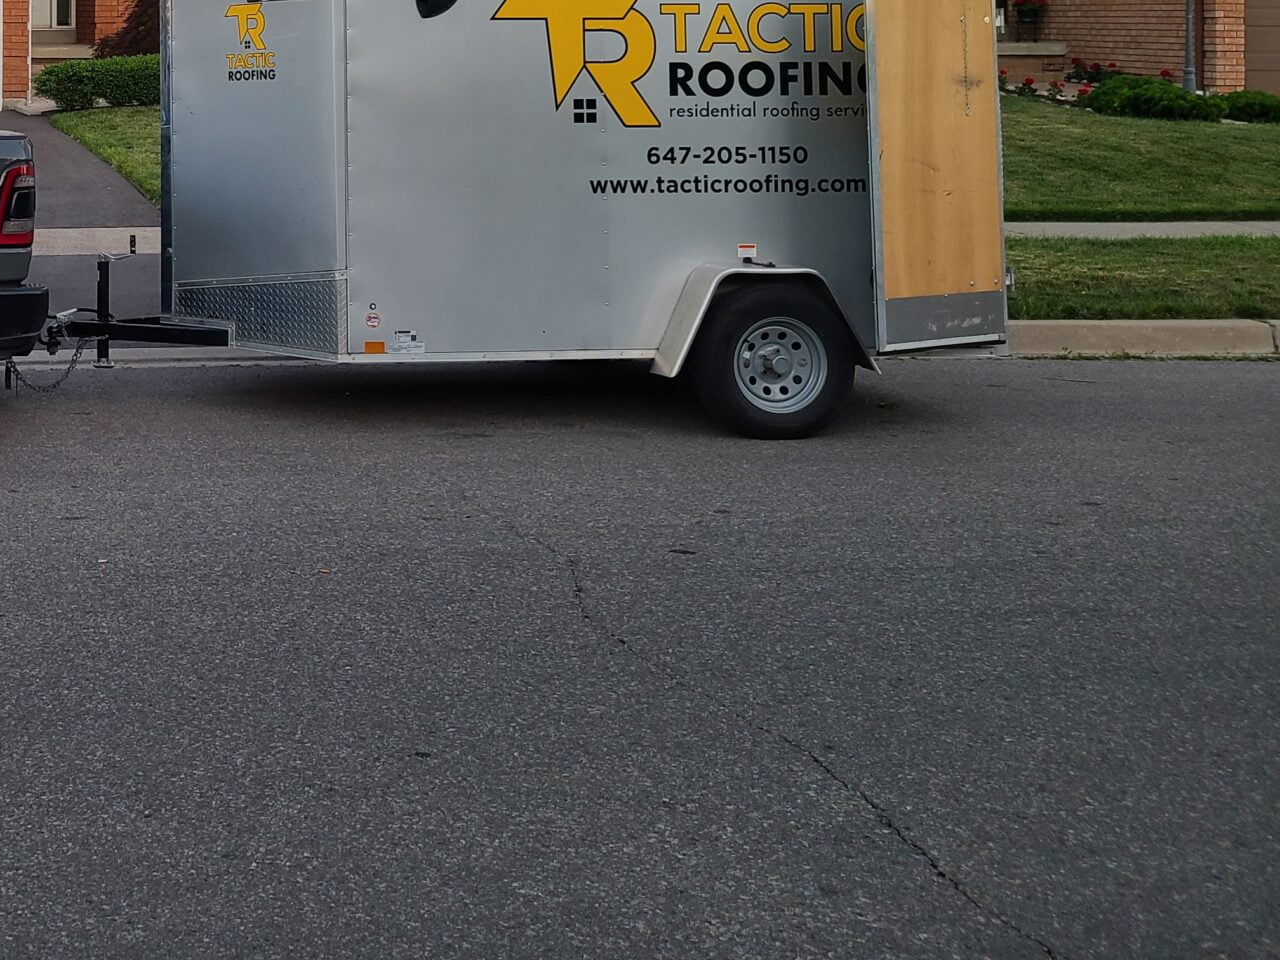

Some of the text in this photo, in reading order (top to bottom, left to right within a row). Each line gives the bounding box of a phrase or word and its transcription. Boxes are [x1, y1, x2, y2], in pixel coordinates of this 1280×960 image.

[226, 52, 276, 69] TACTIC
[228, 69, 276, 81] ROOFING
[668, 61, 866, 97] ROOFIN
[669, 102, 867, 121] residential roofing servi
[646, 146, 808, 165] 647-205-1150
[589, 174, 866, 196] www.tacticroofing.com
